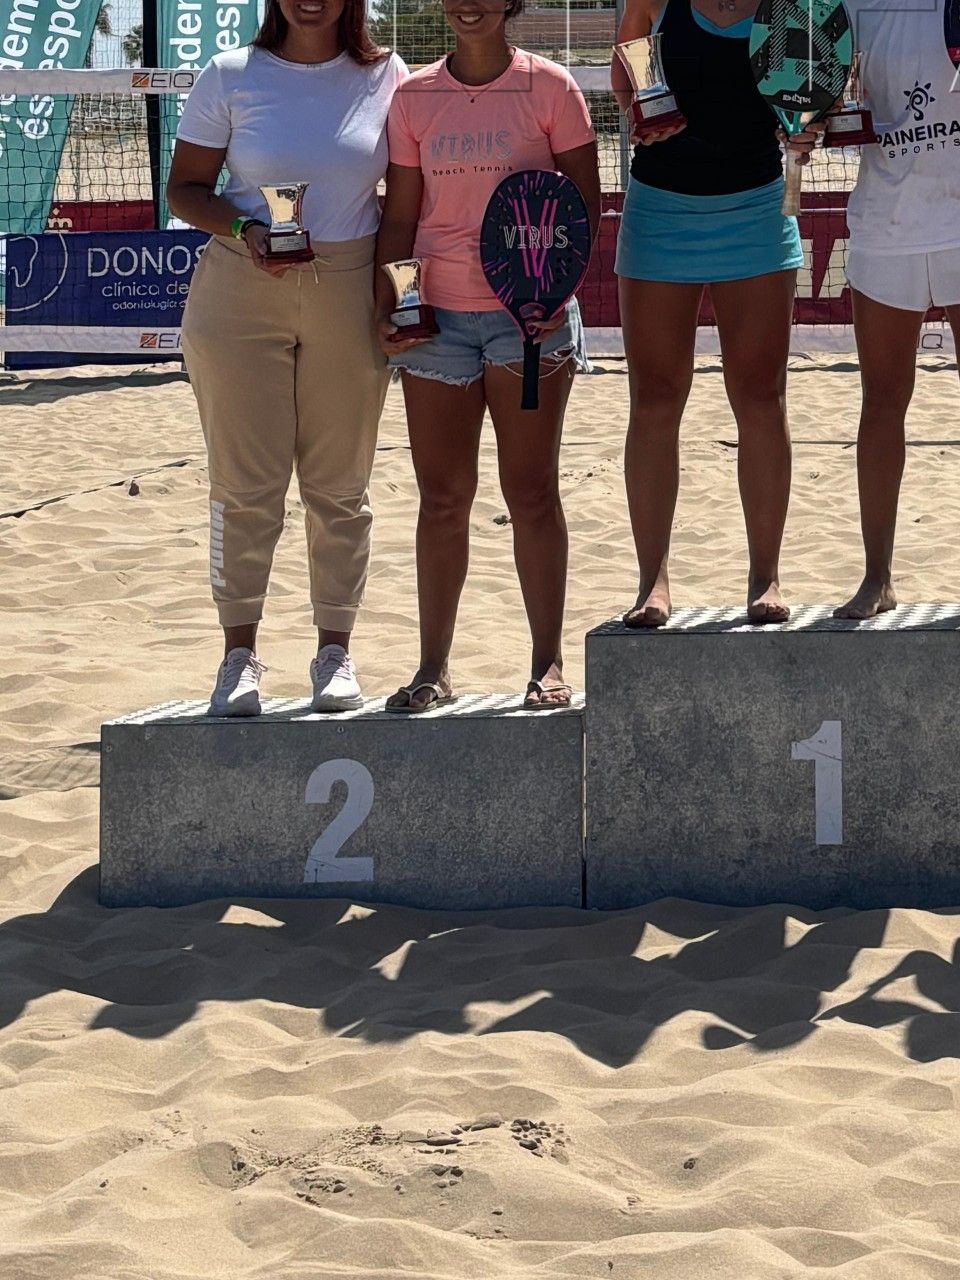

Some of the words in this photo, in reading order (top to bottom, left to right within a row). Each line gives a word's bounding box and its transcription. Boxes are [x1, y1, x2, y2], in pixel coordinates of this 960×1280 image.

[431, 129, 512, 164] VIRUS
[888, 138, 960, 159] SPORTS
[432, 167, 465, 177] Beach
[473, 164, 513, 173] Tennis
[503, 225, 568, 249] VIRUS
[102, 281, 160, 297] clínica
[139, 332, 182, 349] ZEI
[210, 500, 226, 587] PUMA
[790, 719, 842, 848] 1
[302, 758, 375, 884] 2
